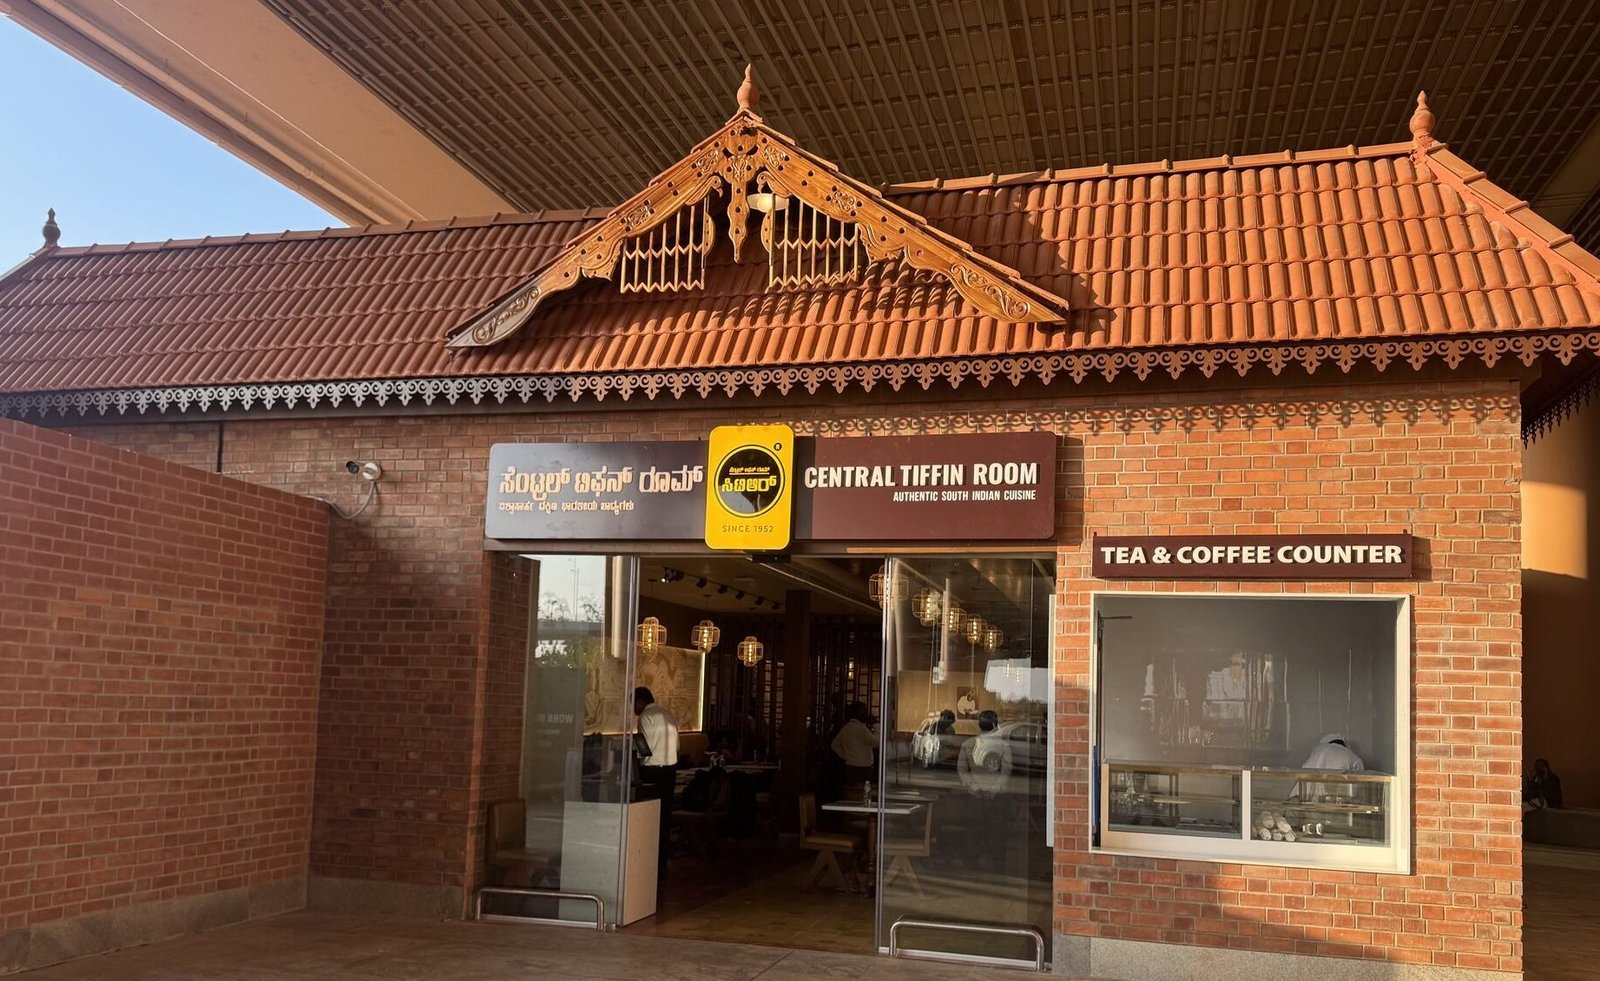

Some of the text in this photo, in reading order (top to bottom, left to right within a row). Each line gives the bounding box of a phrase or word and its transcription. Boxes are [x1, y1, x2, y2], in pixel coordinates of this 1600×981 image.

[499, 464, 704, 501] ಸೆಂಟ್ರಲ್ ಟಿಫನ್ ರೂಮ್
[804, 462, 1037, 489] CENTRAL TIFFIN ROOM
[893, 490, 1036, 502] AUTHENTIC SOUTH INDIAN CUISINE
[722, 525, 774, 533] SINCE 1952
[1101, 545, 1402, 564] TEA & COFFEE COUNTER
